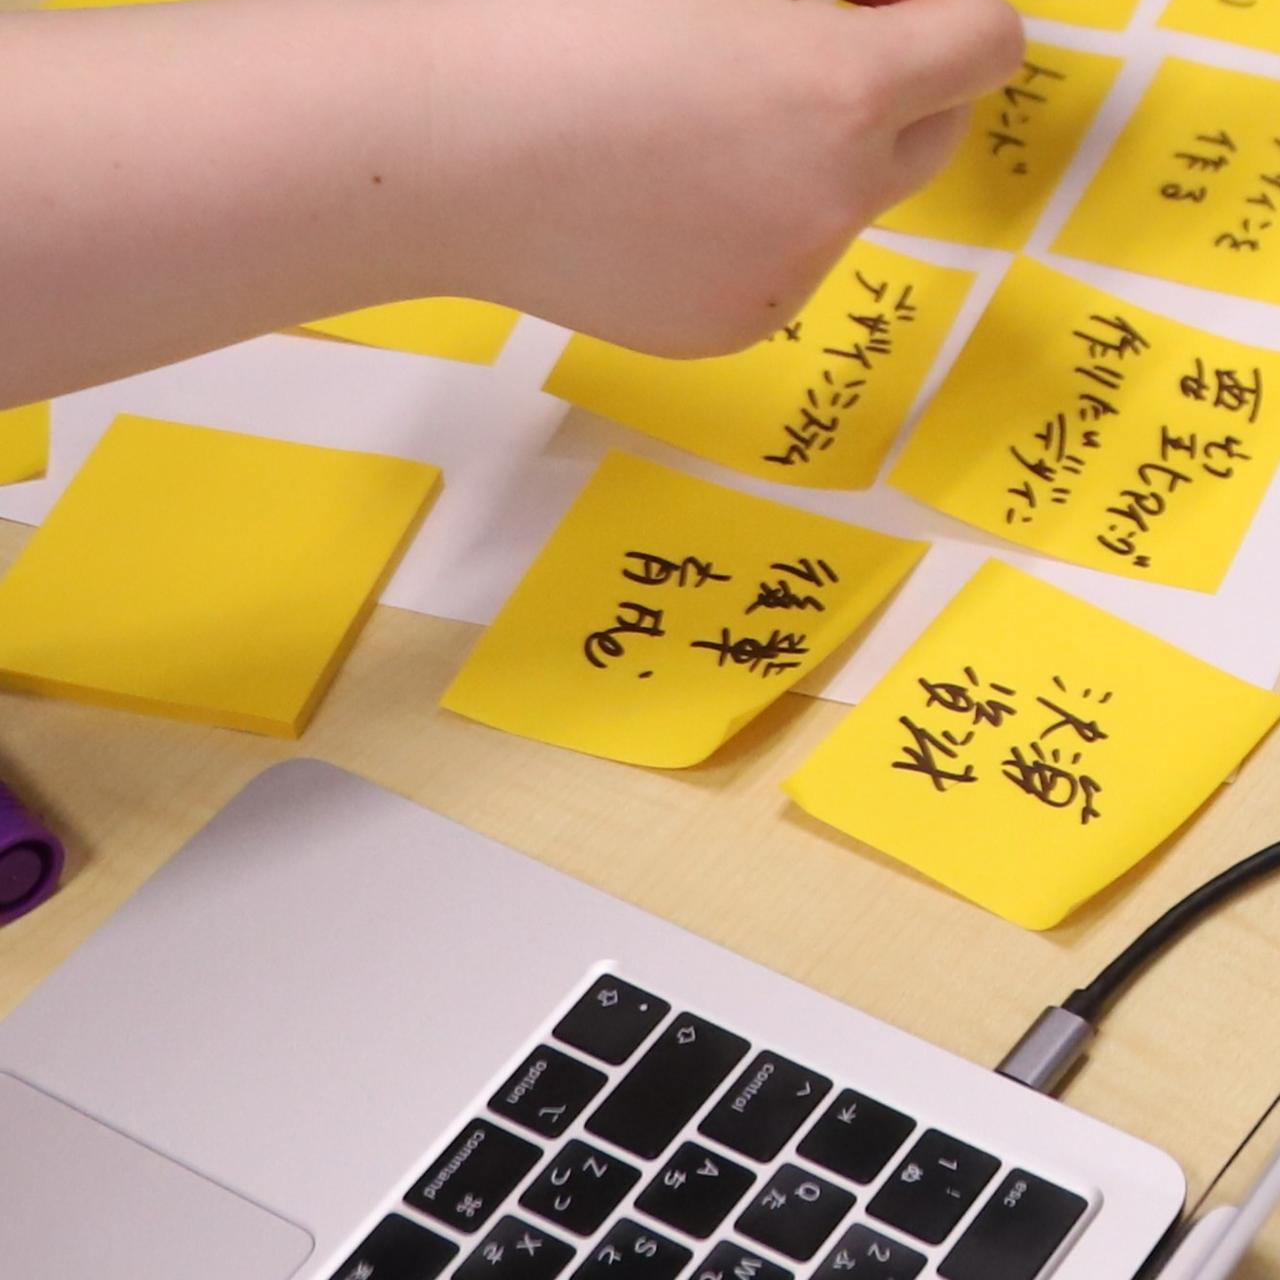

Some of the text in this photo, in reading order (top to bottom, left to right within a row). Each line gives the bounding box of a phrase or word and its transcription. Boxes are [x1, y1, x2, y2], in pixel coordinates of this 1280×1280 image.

[1160, 129, 1238, 203] 作る
[762, 271, 917, 469] デザインシステム
[690, 557, 840, 677] 後輩
[506, 1059, 548, 1104] option
[731, 1063, 774, 1113] control
[423, 1129, 486, 1200] command
[583, 1156, 608, 1179] Z
[696, 1157, 721, 1180] A
[663, 1169, 688, 1190] ち
[794, 1181, 821, 1202] Q
[761, 1187, 787, 1211] た
[1003, 1179, 1029, 1208] esc
[516, 1231, 544, 1257] X
[633, 1235, 658, 1258] S
[868, 1243, 891, 1263] 2
[733, 1256, 764, 1278] W
